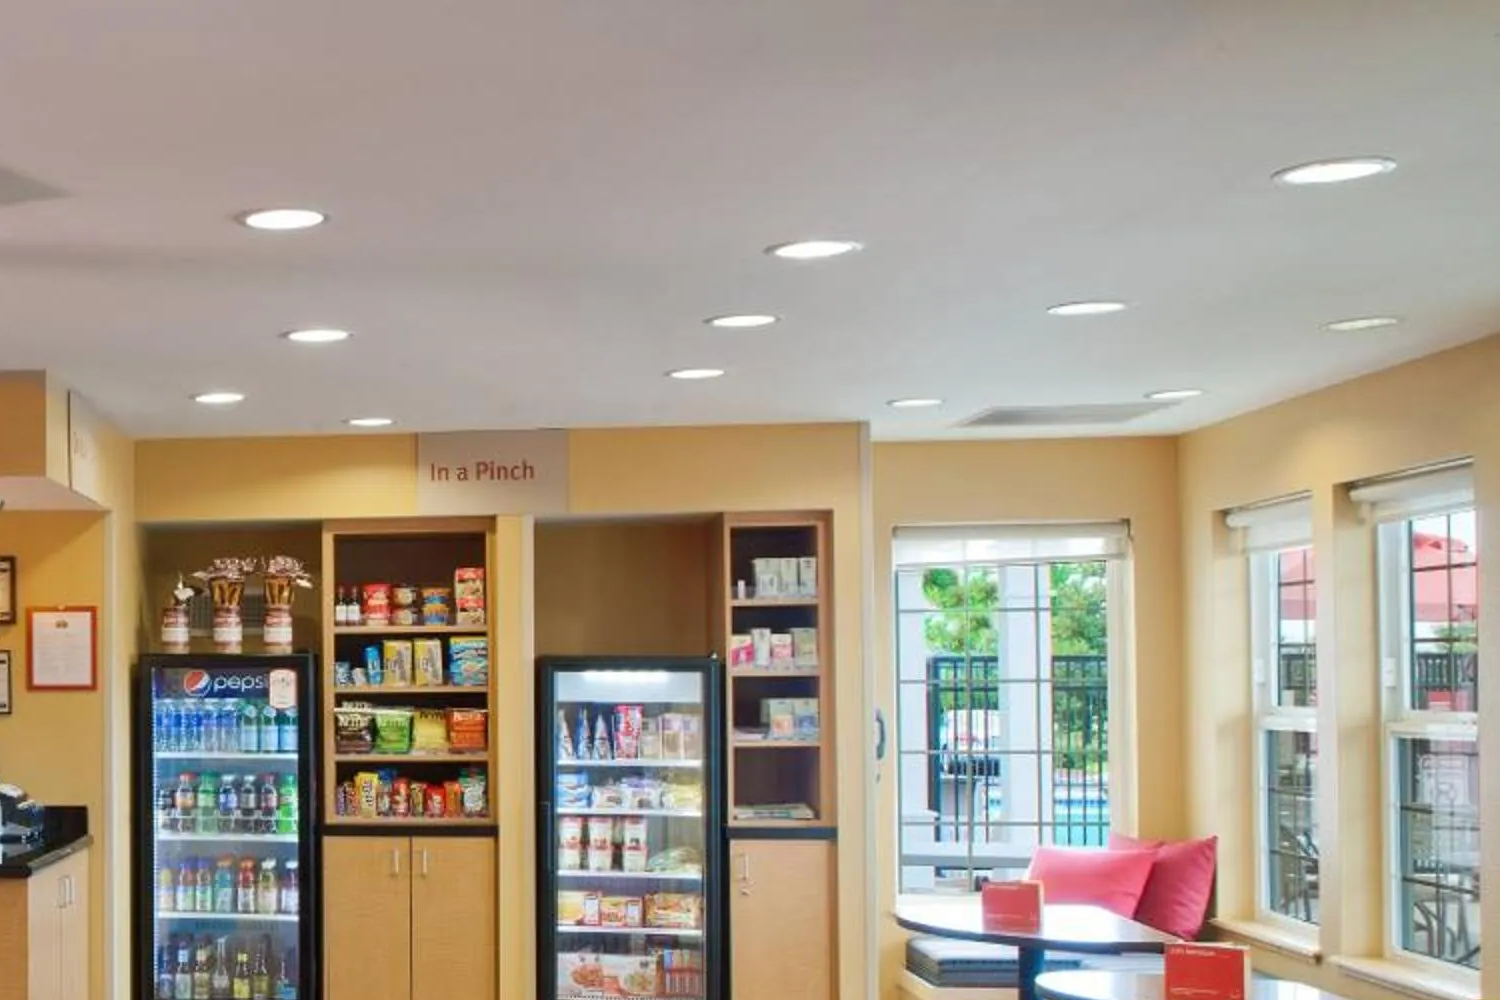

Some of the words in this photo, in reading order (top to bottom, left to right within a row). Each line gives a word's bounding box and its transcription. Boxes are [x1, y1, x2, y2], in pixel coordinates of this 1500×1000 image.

[430, 462, 450, 481] In
[456, 467, 469, 481] a
[475, 459, 535, 481] Pinch
